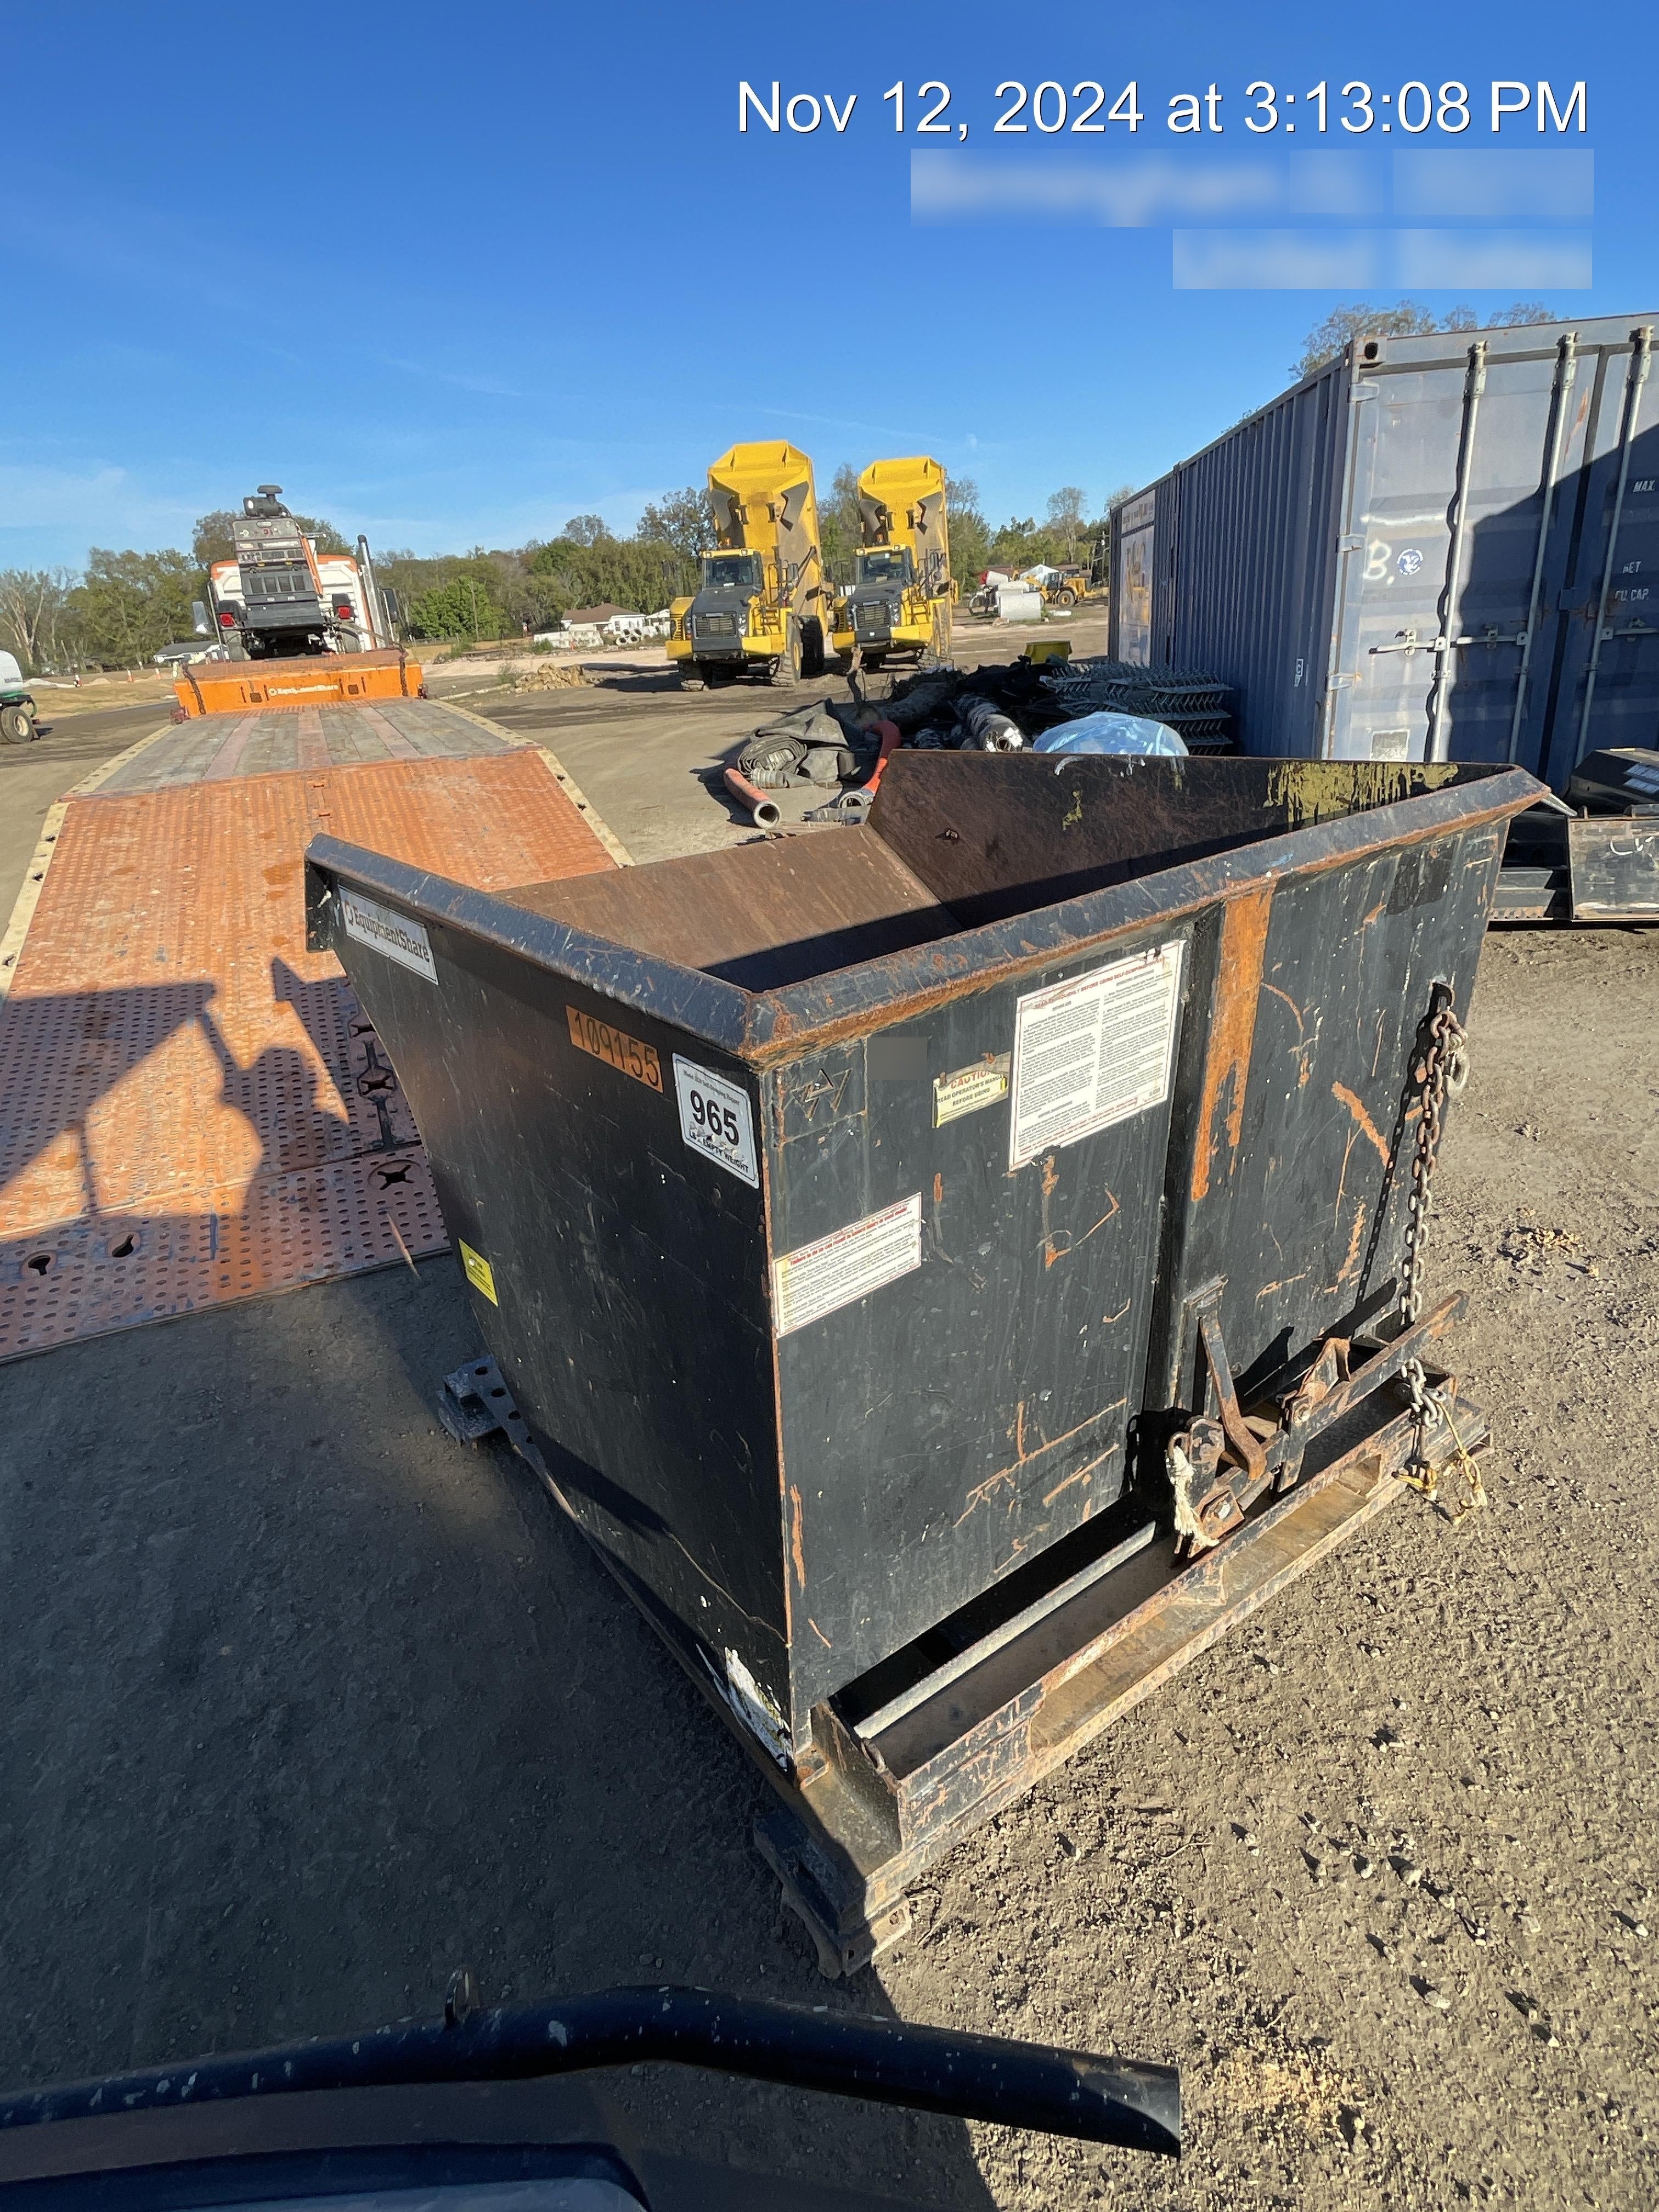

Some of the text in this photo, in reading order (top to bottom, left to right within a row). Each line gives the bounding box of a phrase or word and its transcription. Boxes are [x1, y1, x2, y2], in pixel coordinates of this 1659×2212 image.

[352, 905, 430, 963] EquipmentShare
[575, 1012, 659, 1087] 109155
[690, 1090, 740, 1146] 965
[702, 1137, 723, 1156] EMPTY
[724, 1151, 749, 1173] WEIGHT
